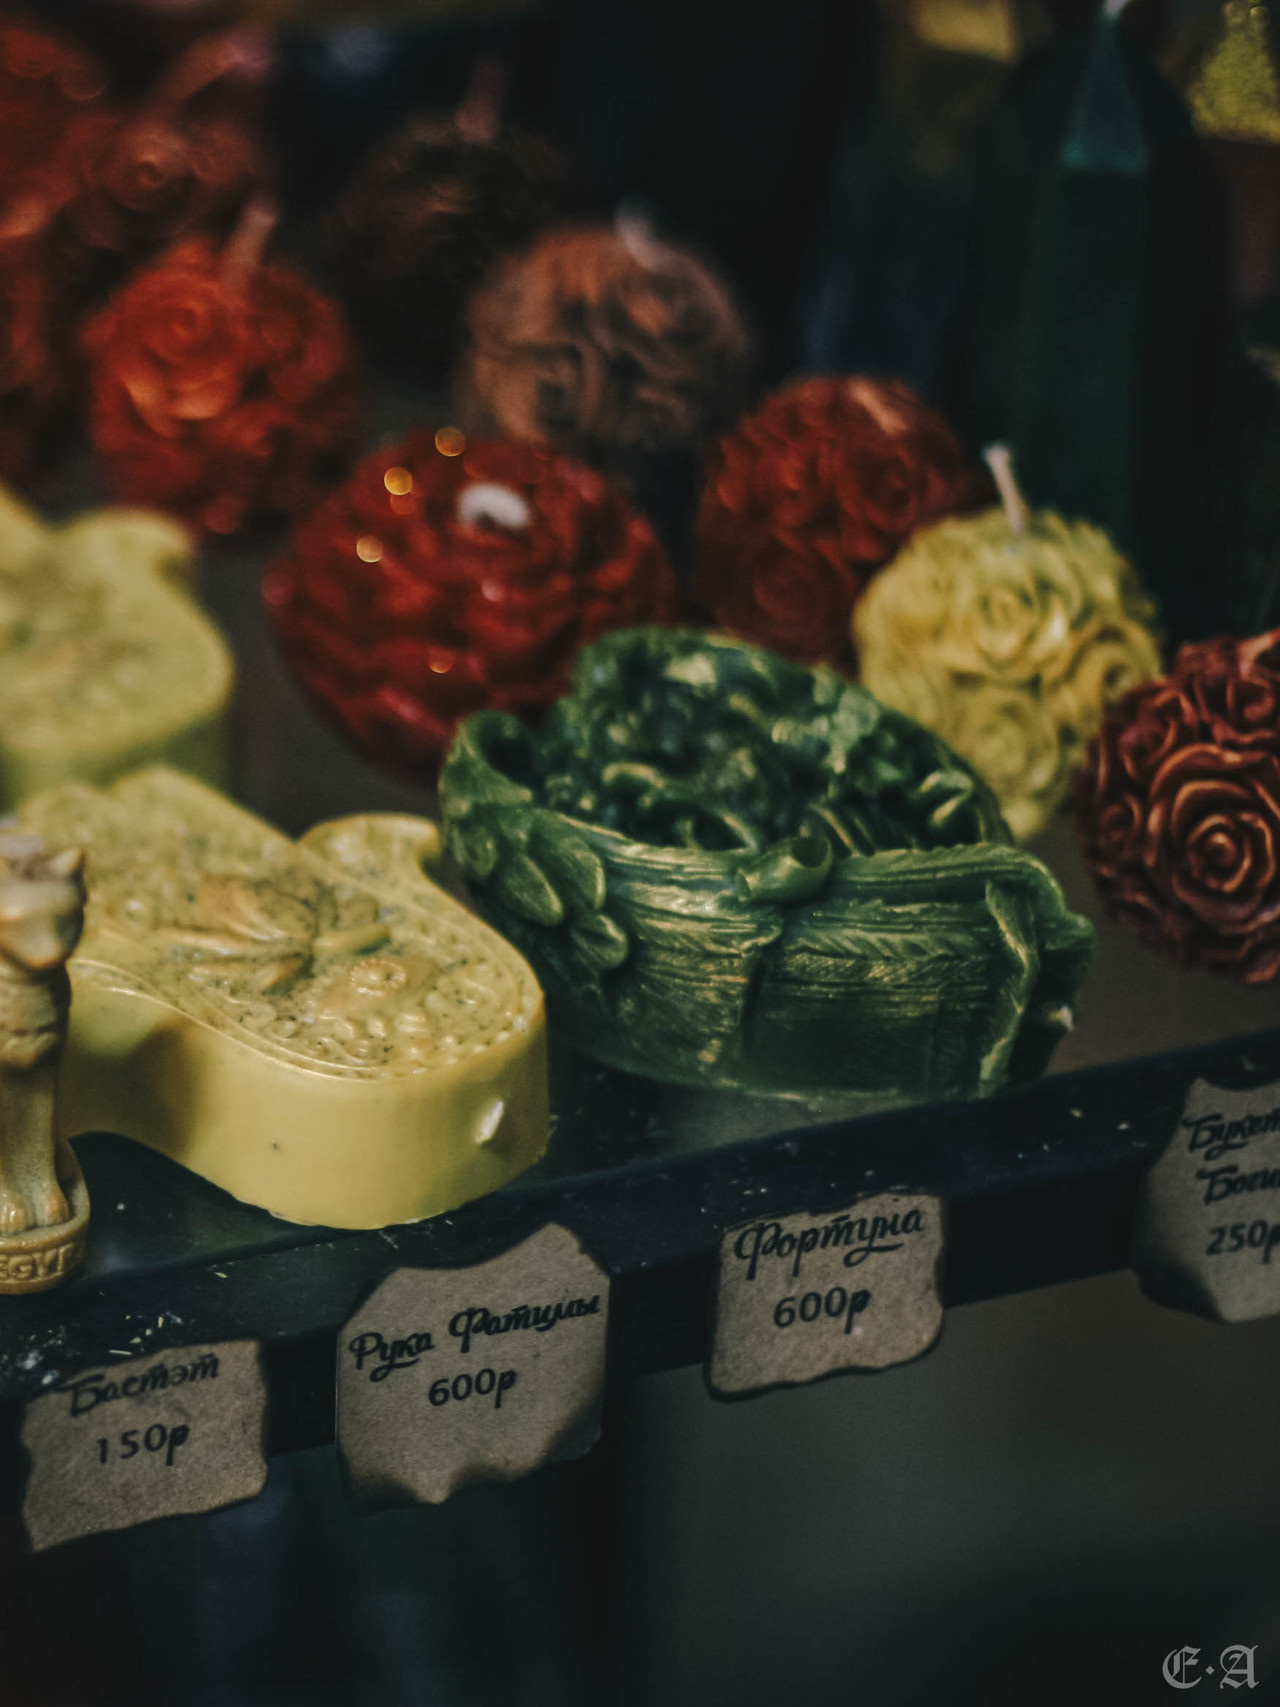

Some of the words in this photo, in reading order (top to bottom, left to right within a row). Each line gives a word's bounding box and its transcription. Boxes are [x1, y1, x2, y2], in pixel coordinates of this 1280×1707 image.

[734, 1209, 923, 1281] Фортуна
[774, 1286, 870, 1334] 600р
[349, 1332, 434, 1382] Рука
[448, 1295, 600, 1354] Фатимы
[56, 1352, 220, 1417] Бастэт
[428, 1368, 516, 1409] 600р
[97, 1423, 190, 1466] 150р
